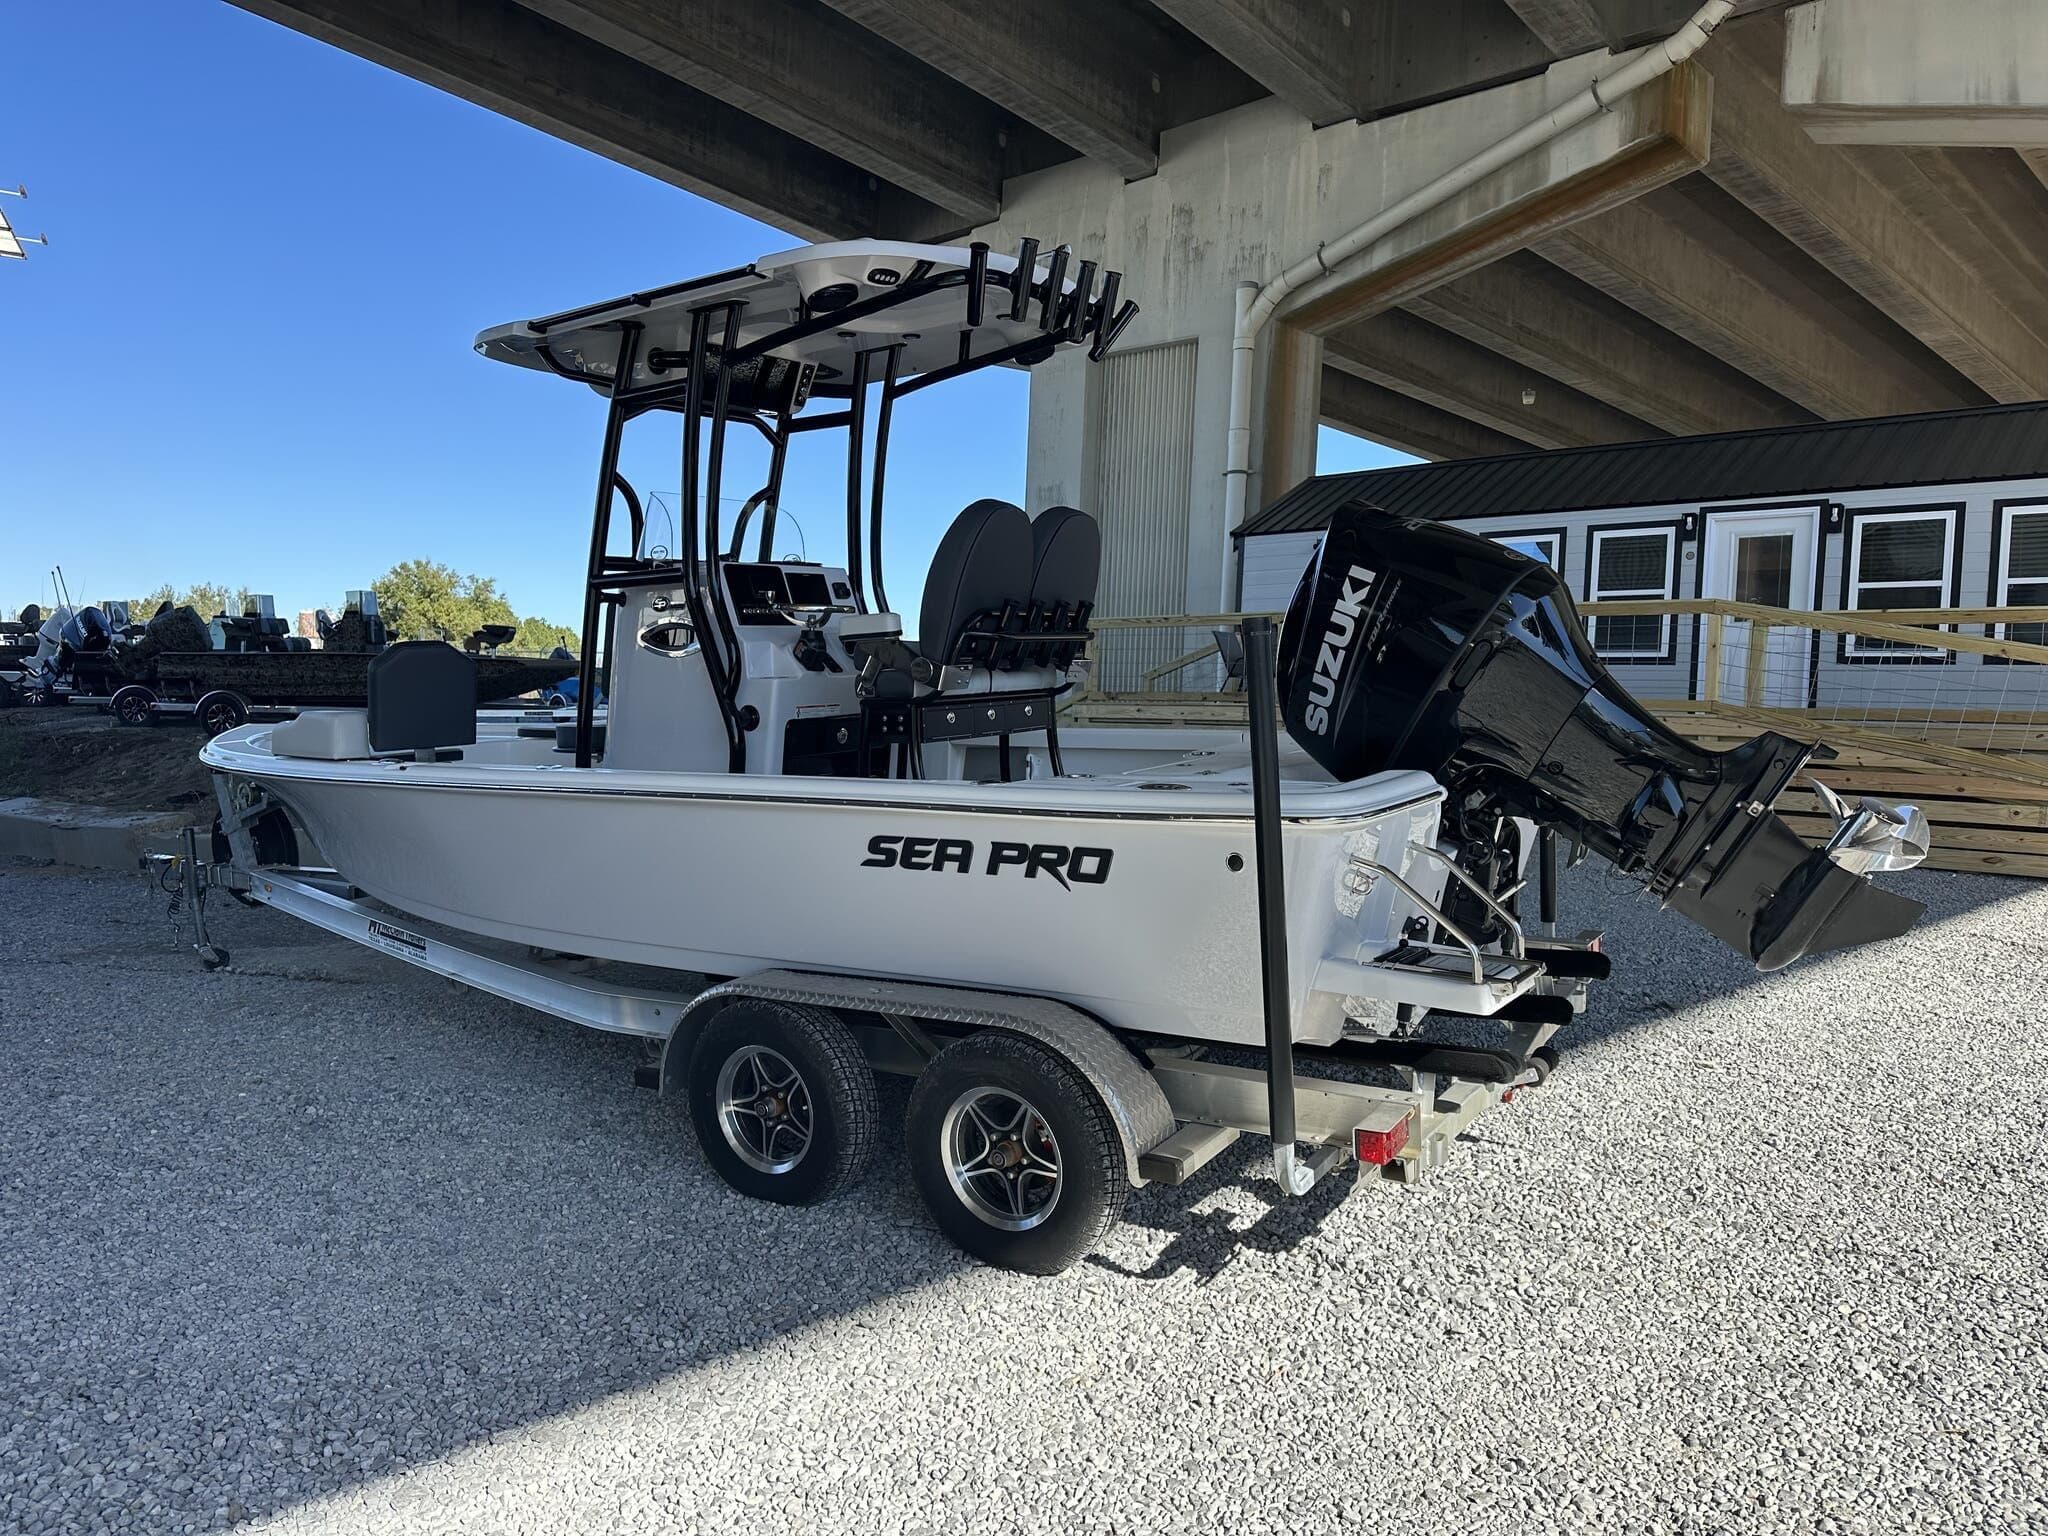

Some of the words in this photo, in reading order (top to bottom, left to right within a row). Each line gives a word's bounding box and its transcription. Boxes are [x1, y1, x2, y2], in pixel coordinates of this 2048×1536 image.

[1305, 564, 1376, 736] SUZUKI
[860, 835, 975, 874] SEA
[986, 841, 1114, 892] PRO
